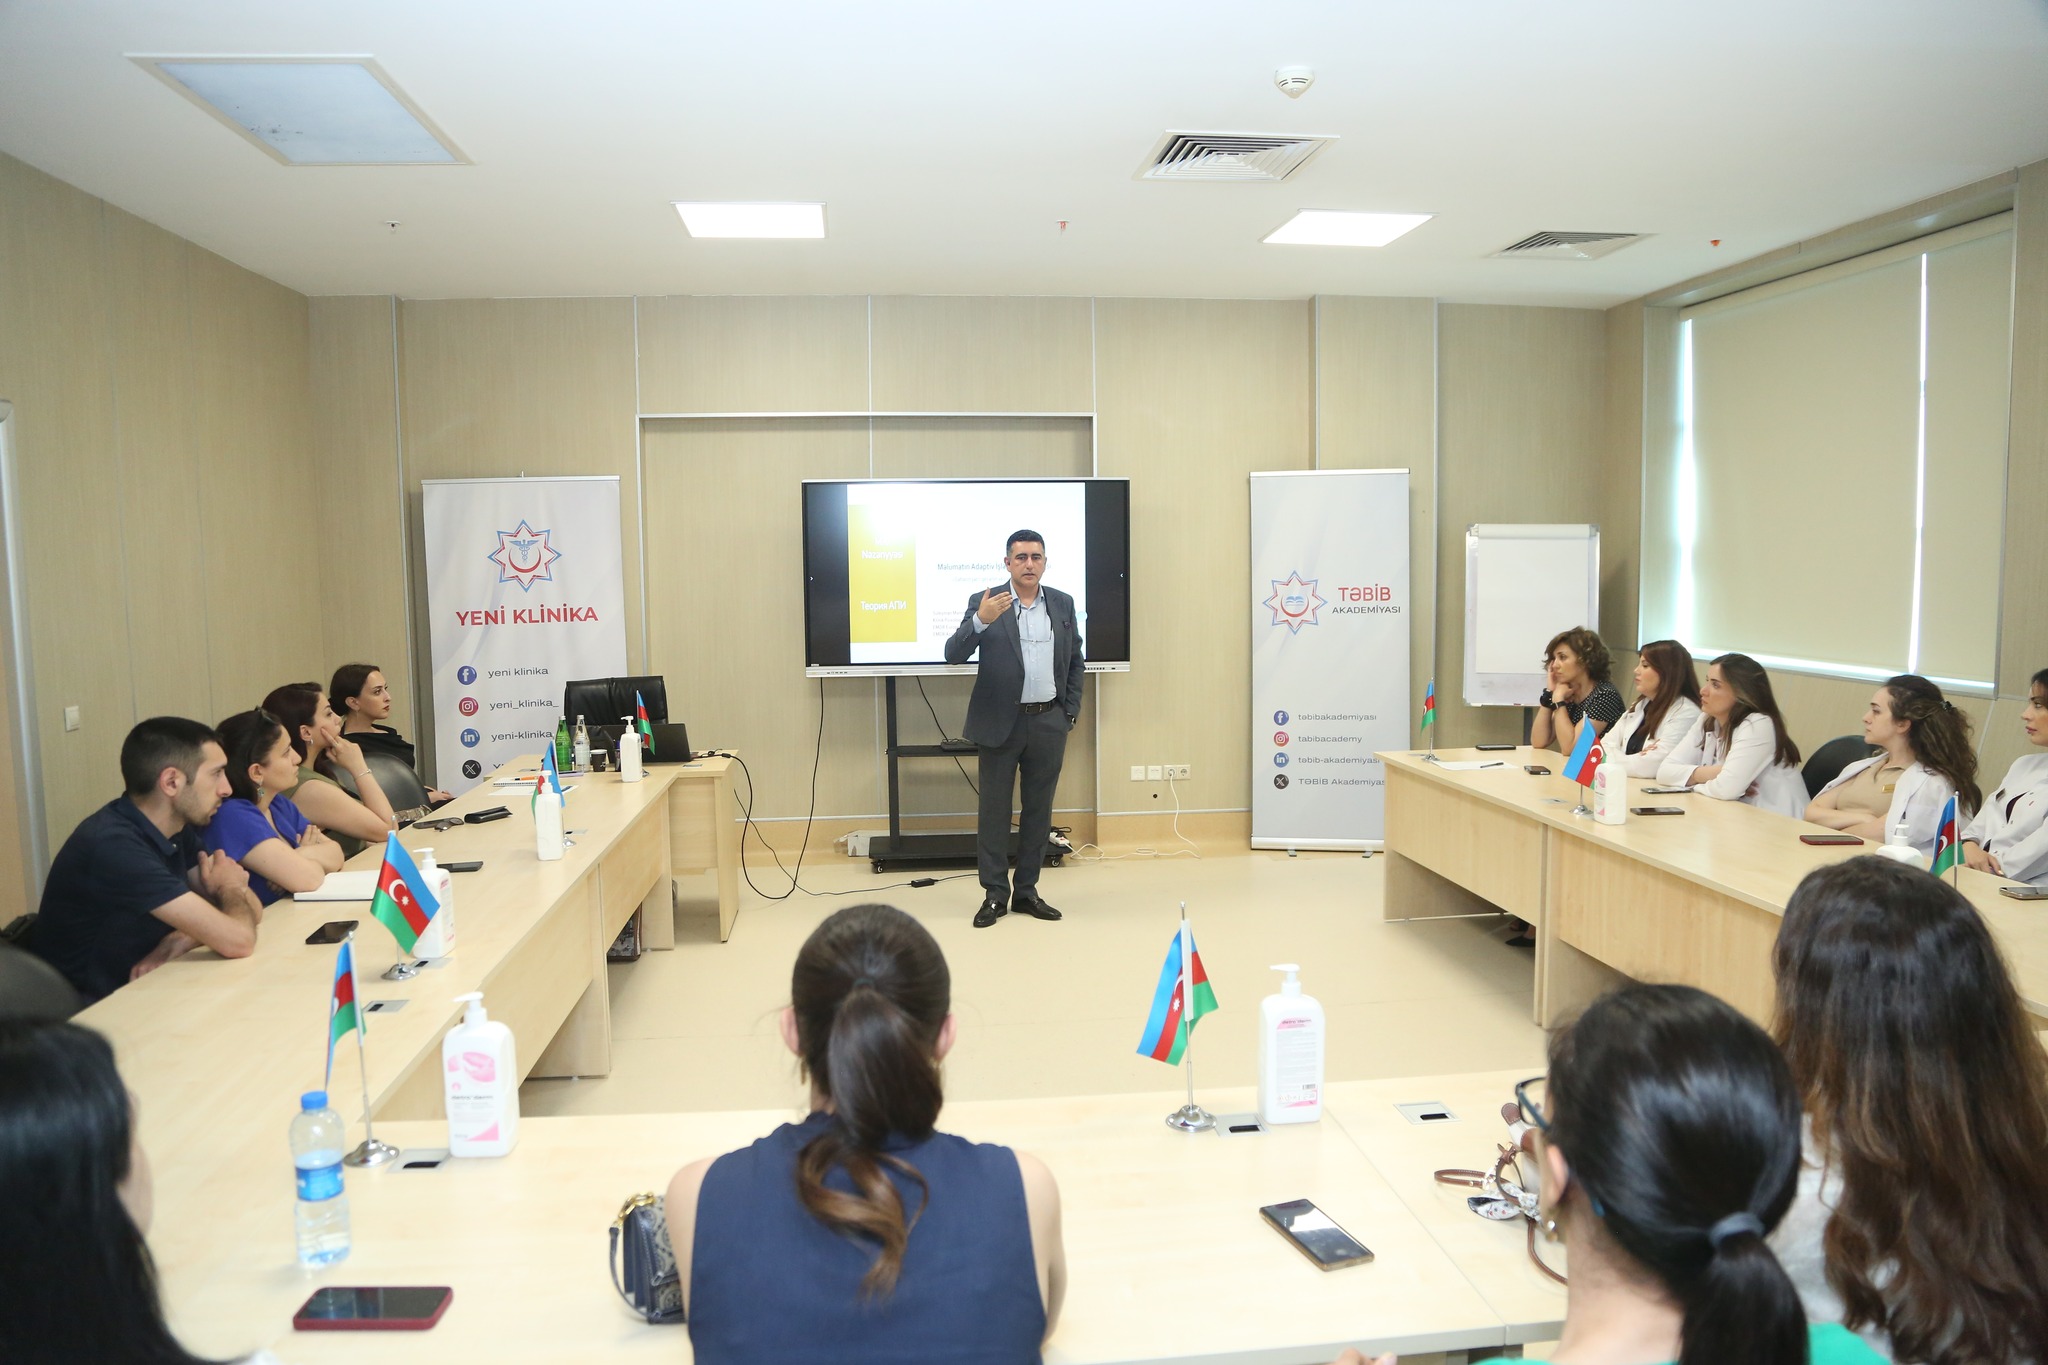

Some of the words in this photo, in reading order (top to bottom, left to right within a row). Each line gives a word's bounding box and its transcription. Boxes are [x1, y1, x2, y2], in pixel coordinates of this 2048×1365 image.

[1338, 583, 1391, 601] TƏBİB
[861, 601, 888, 612] Теория
[889, 600, 907, 610] АПИ
[1332, 605, 1401, 614] AKADEMİYASI
[455, 605, 506, 626] YENİ
[513, 603, 599, 624] KLİNİKA
[488, 668, 511, 679] yeni
[514, 667, 549, 676] klinika
[490, 699, 559, 711] yeni_klinika_
[491, 730, 553, 742] yeni-klinika
[1331, 778, 1385, 787] Akademiyas
